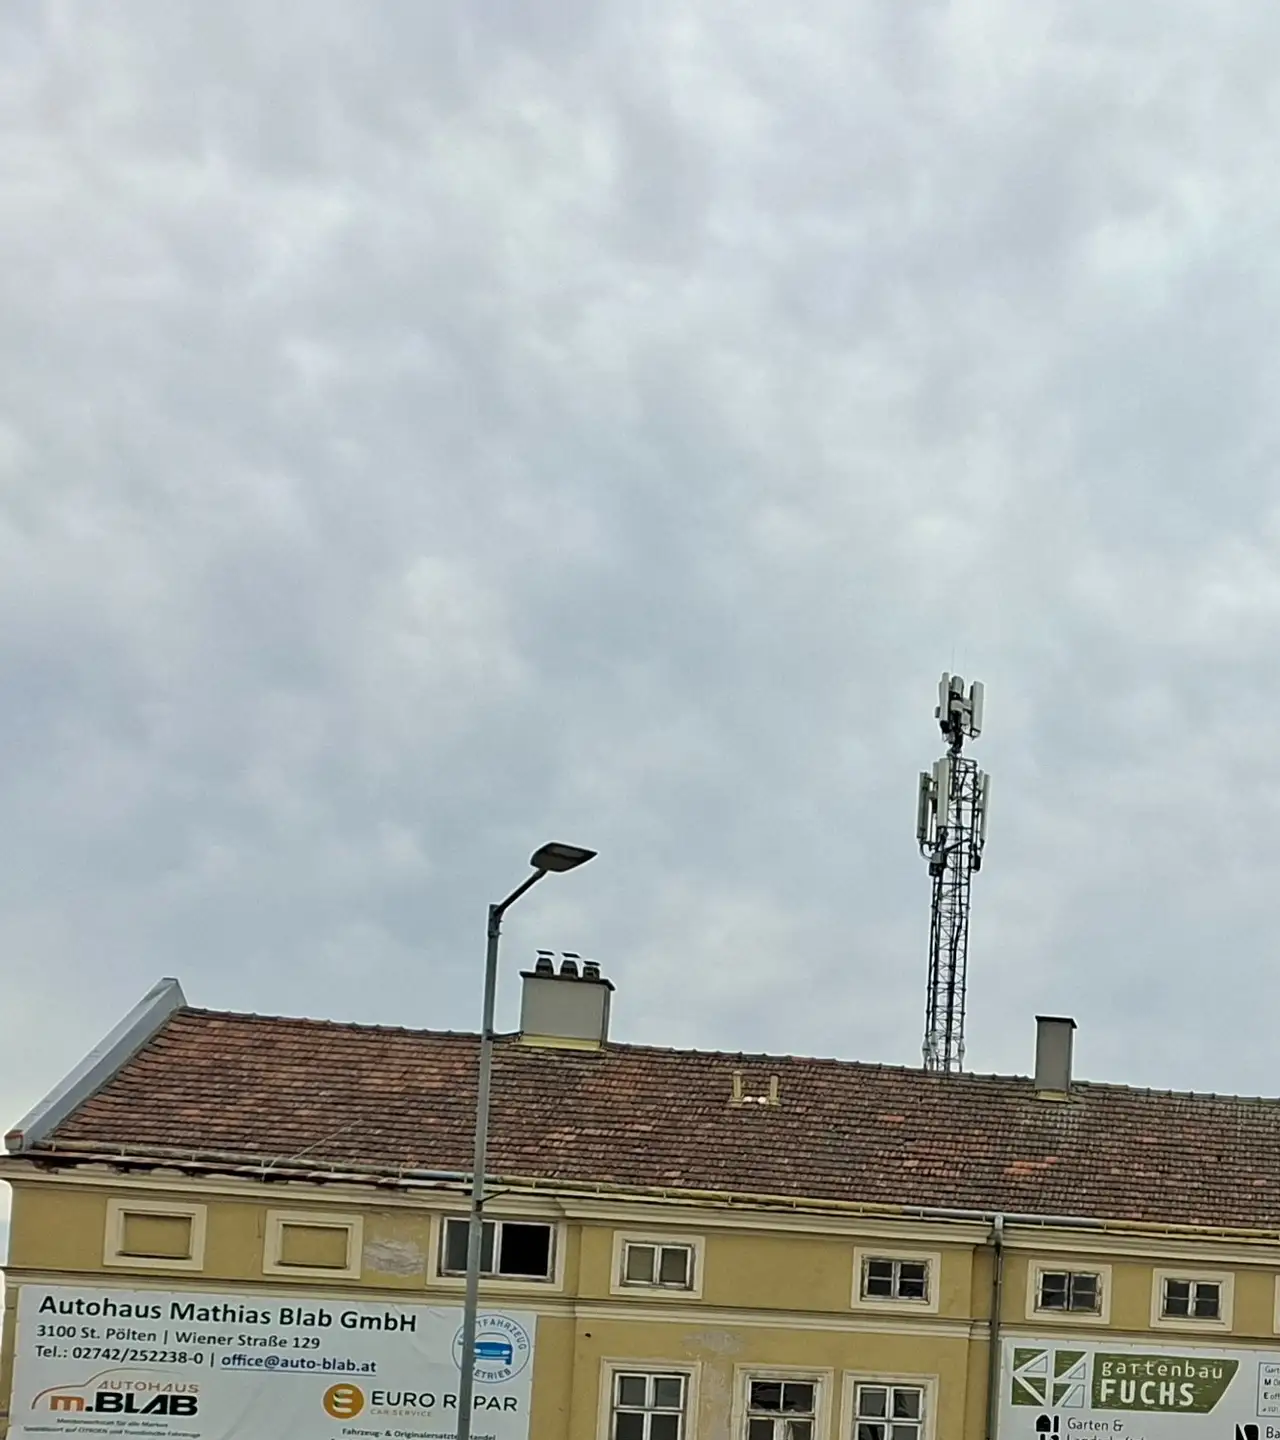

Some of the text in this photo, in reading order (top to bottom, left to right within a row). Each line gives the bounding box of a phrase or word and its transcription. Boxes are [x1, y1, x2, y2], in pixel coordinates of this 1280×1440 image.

[38, 1295, 417, 1332] Autohaus Mathias Blab GmbH
[36, 1324, 77, 1338] 3100
[80, 1326, 101, 1340] St.
[106, 1328, 157, 1342] Pölten
[176, 1331, 233, 1346] Wiener
[237, 1334, 288, 1348] Straße
[292, 1337, 320, 1350] 129
[35, 1345, 68, 1358] Tel.:
[72, 1346, 203, 1364] 02742/252238-0
[221, 1353, 377, 1374] office@auto-blab.at
[1101, 1360, 1223, 1379] gartenbau
[473, 1367, 512, 1380] ETRIEB
[97, 1380, 200, 1394] AUTOHAUS
[1100, 1378, 1195, 1406] FUCHS
[50, 1391, 198, 1416] m.BLAB
[371, 1390, 518, 1412] EURO RPAR
[391, 1410, 432, 1418] SERVICE
[1066, 1417, 1124, 1432] Garten &
